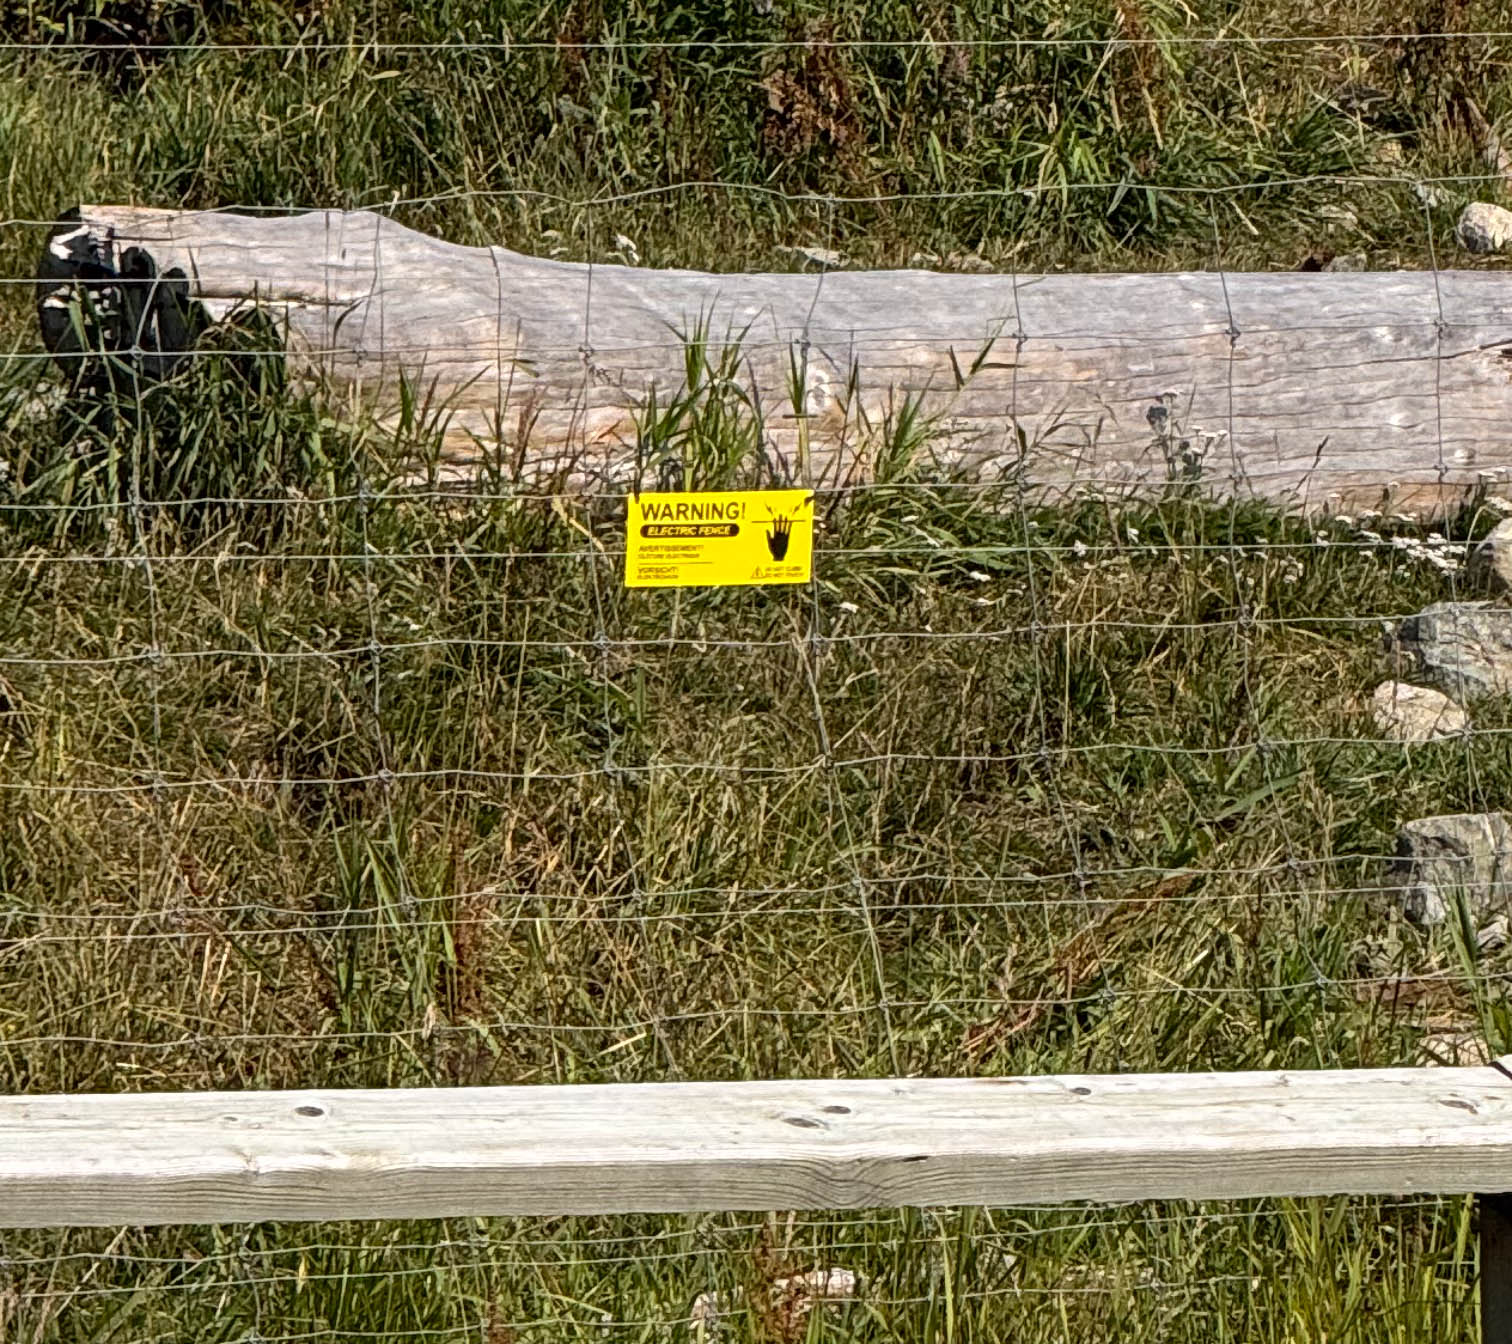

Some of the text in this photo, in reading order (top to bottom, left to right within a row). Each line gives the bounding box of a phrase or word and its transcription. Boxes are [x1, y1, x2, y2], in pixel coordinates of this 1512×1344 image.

[641, 502, 746, 520] WARNING!
[647, 525, 731, 536] ELECTRIC FENCE
